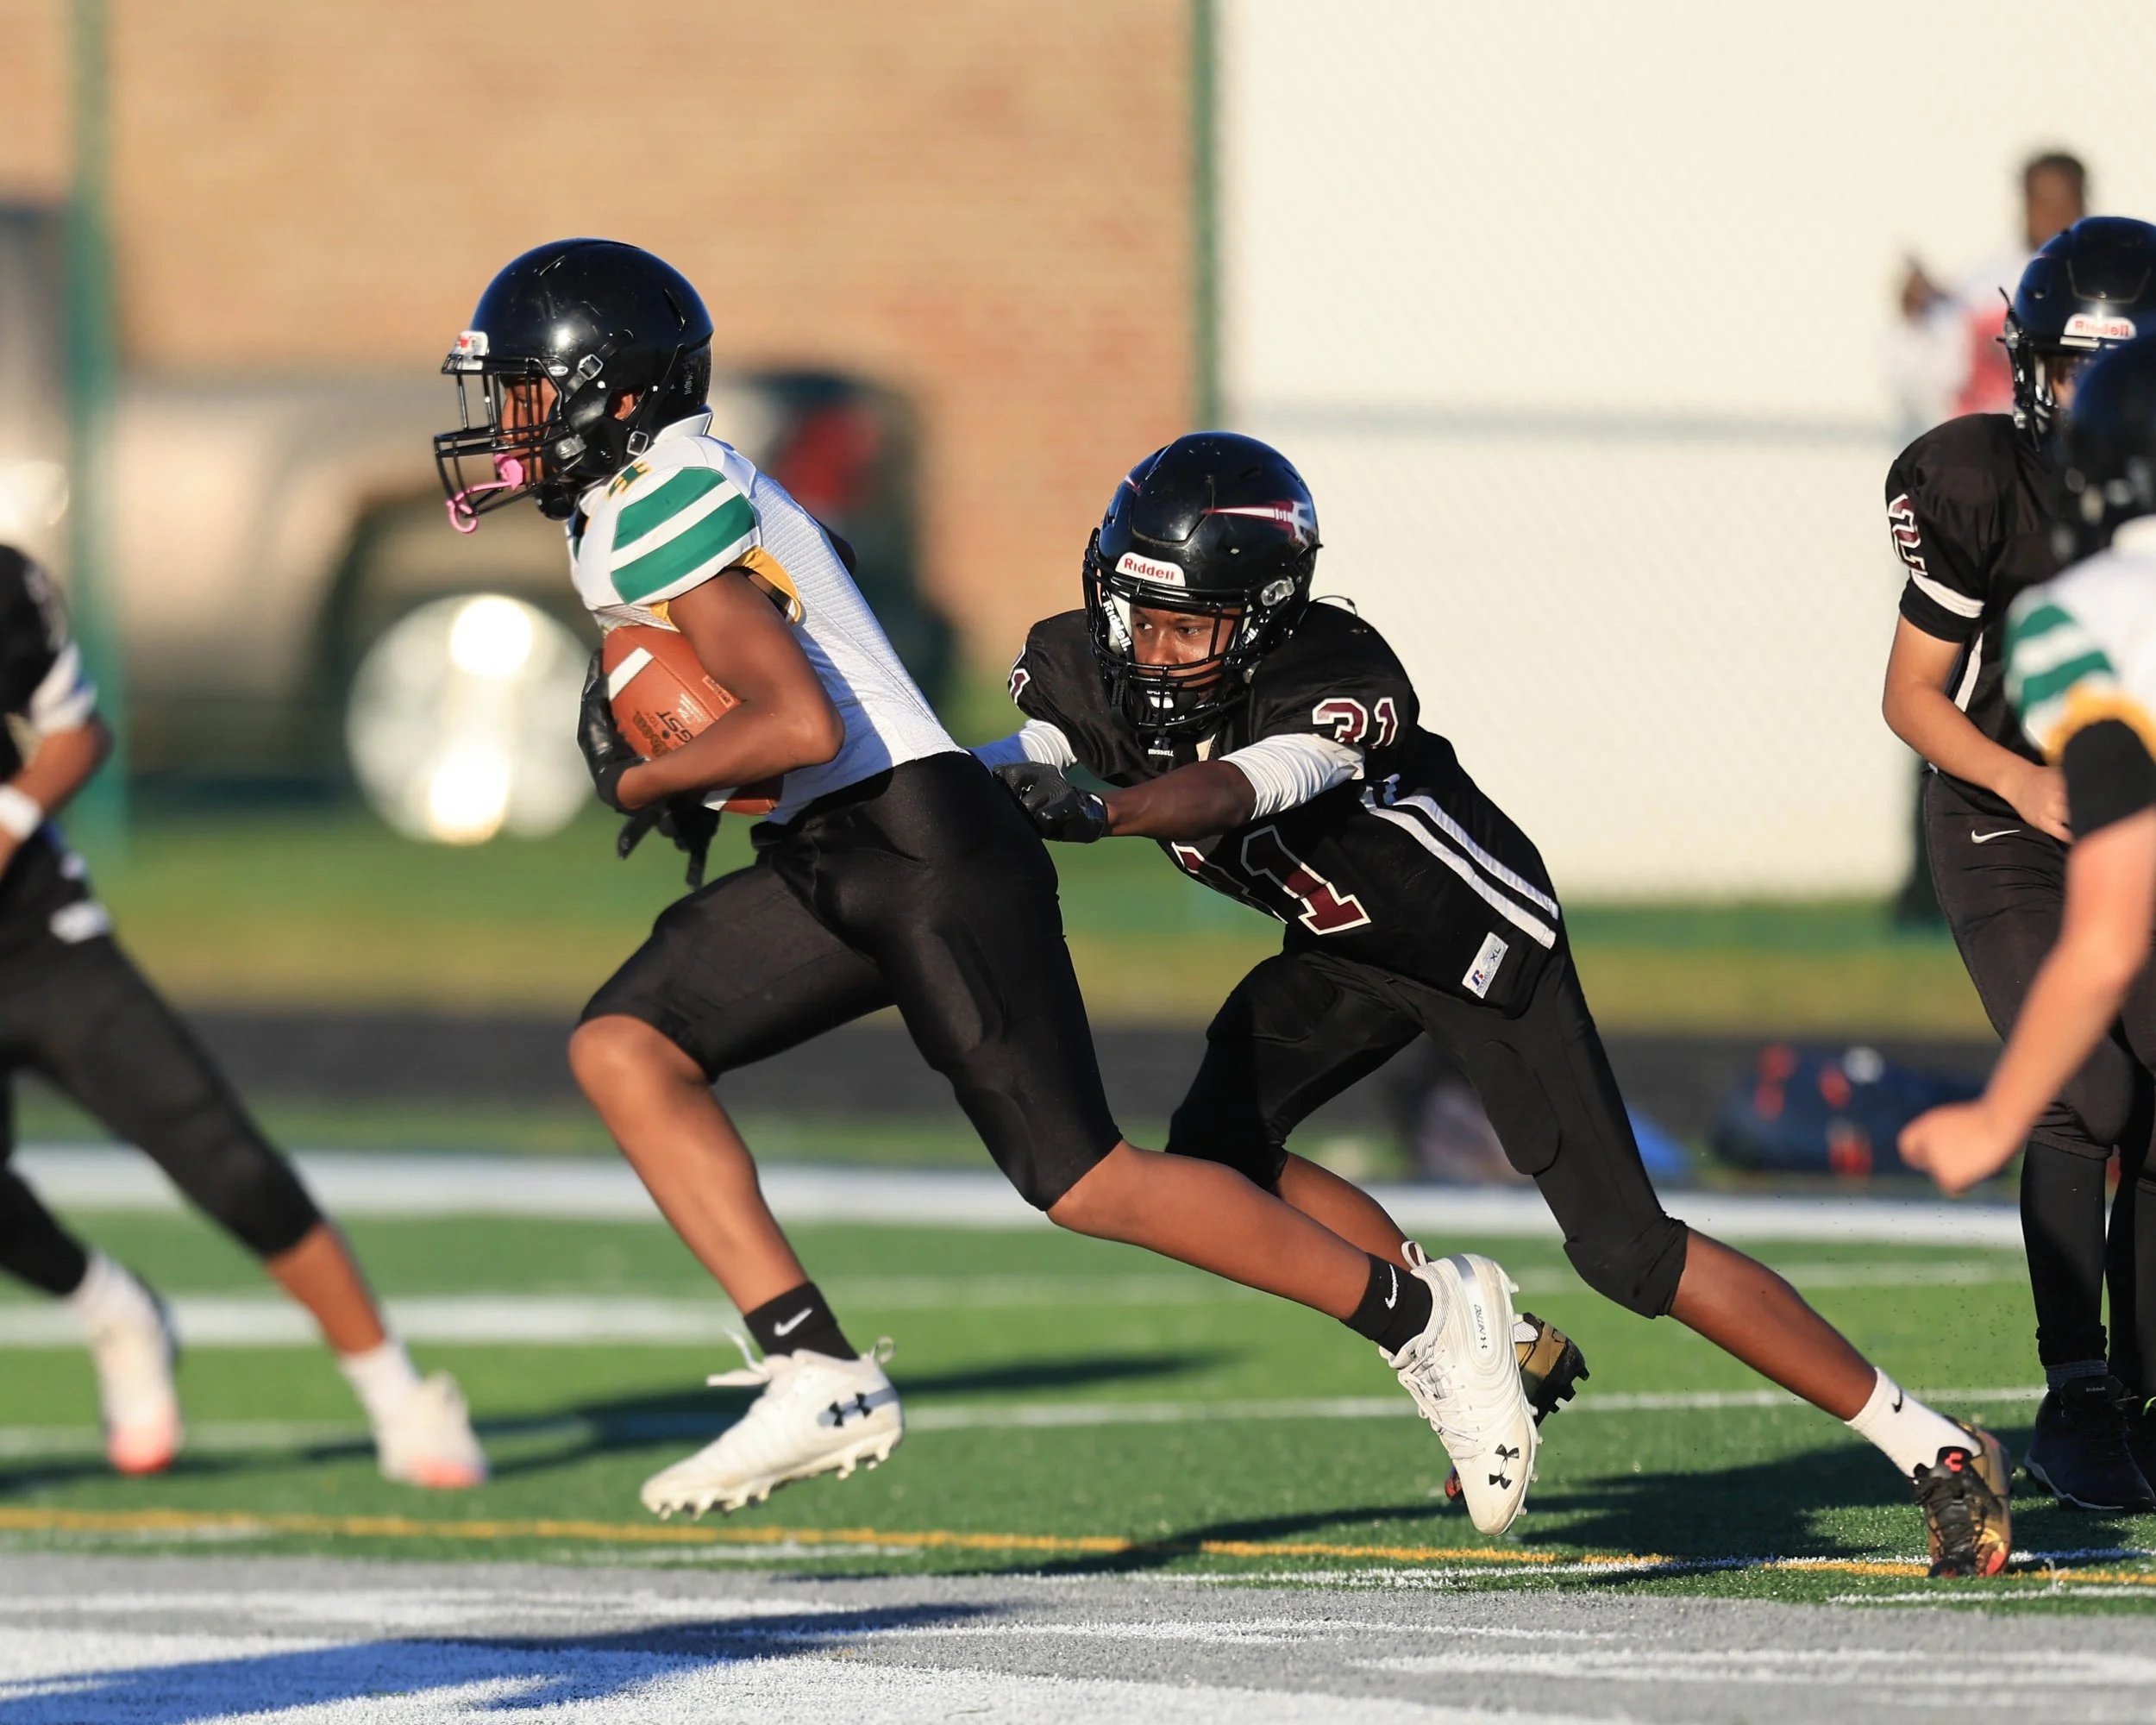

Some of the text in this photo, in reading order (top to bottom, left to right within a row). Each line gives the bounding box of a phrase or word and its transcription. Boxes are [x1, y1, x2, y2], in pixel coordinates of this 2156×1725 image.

[1124, 557, 1175, 580] Riddell
[1007, 642, 1031, 705] 1
[655, 711, 696, 743] GST
[1312, 696, 1399, 749] 31
[1490, 948, 1501, 963] XL
[1474, 1304, 1487, 1335] NITRO
